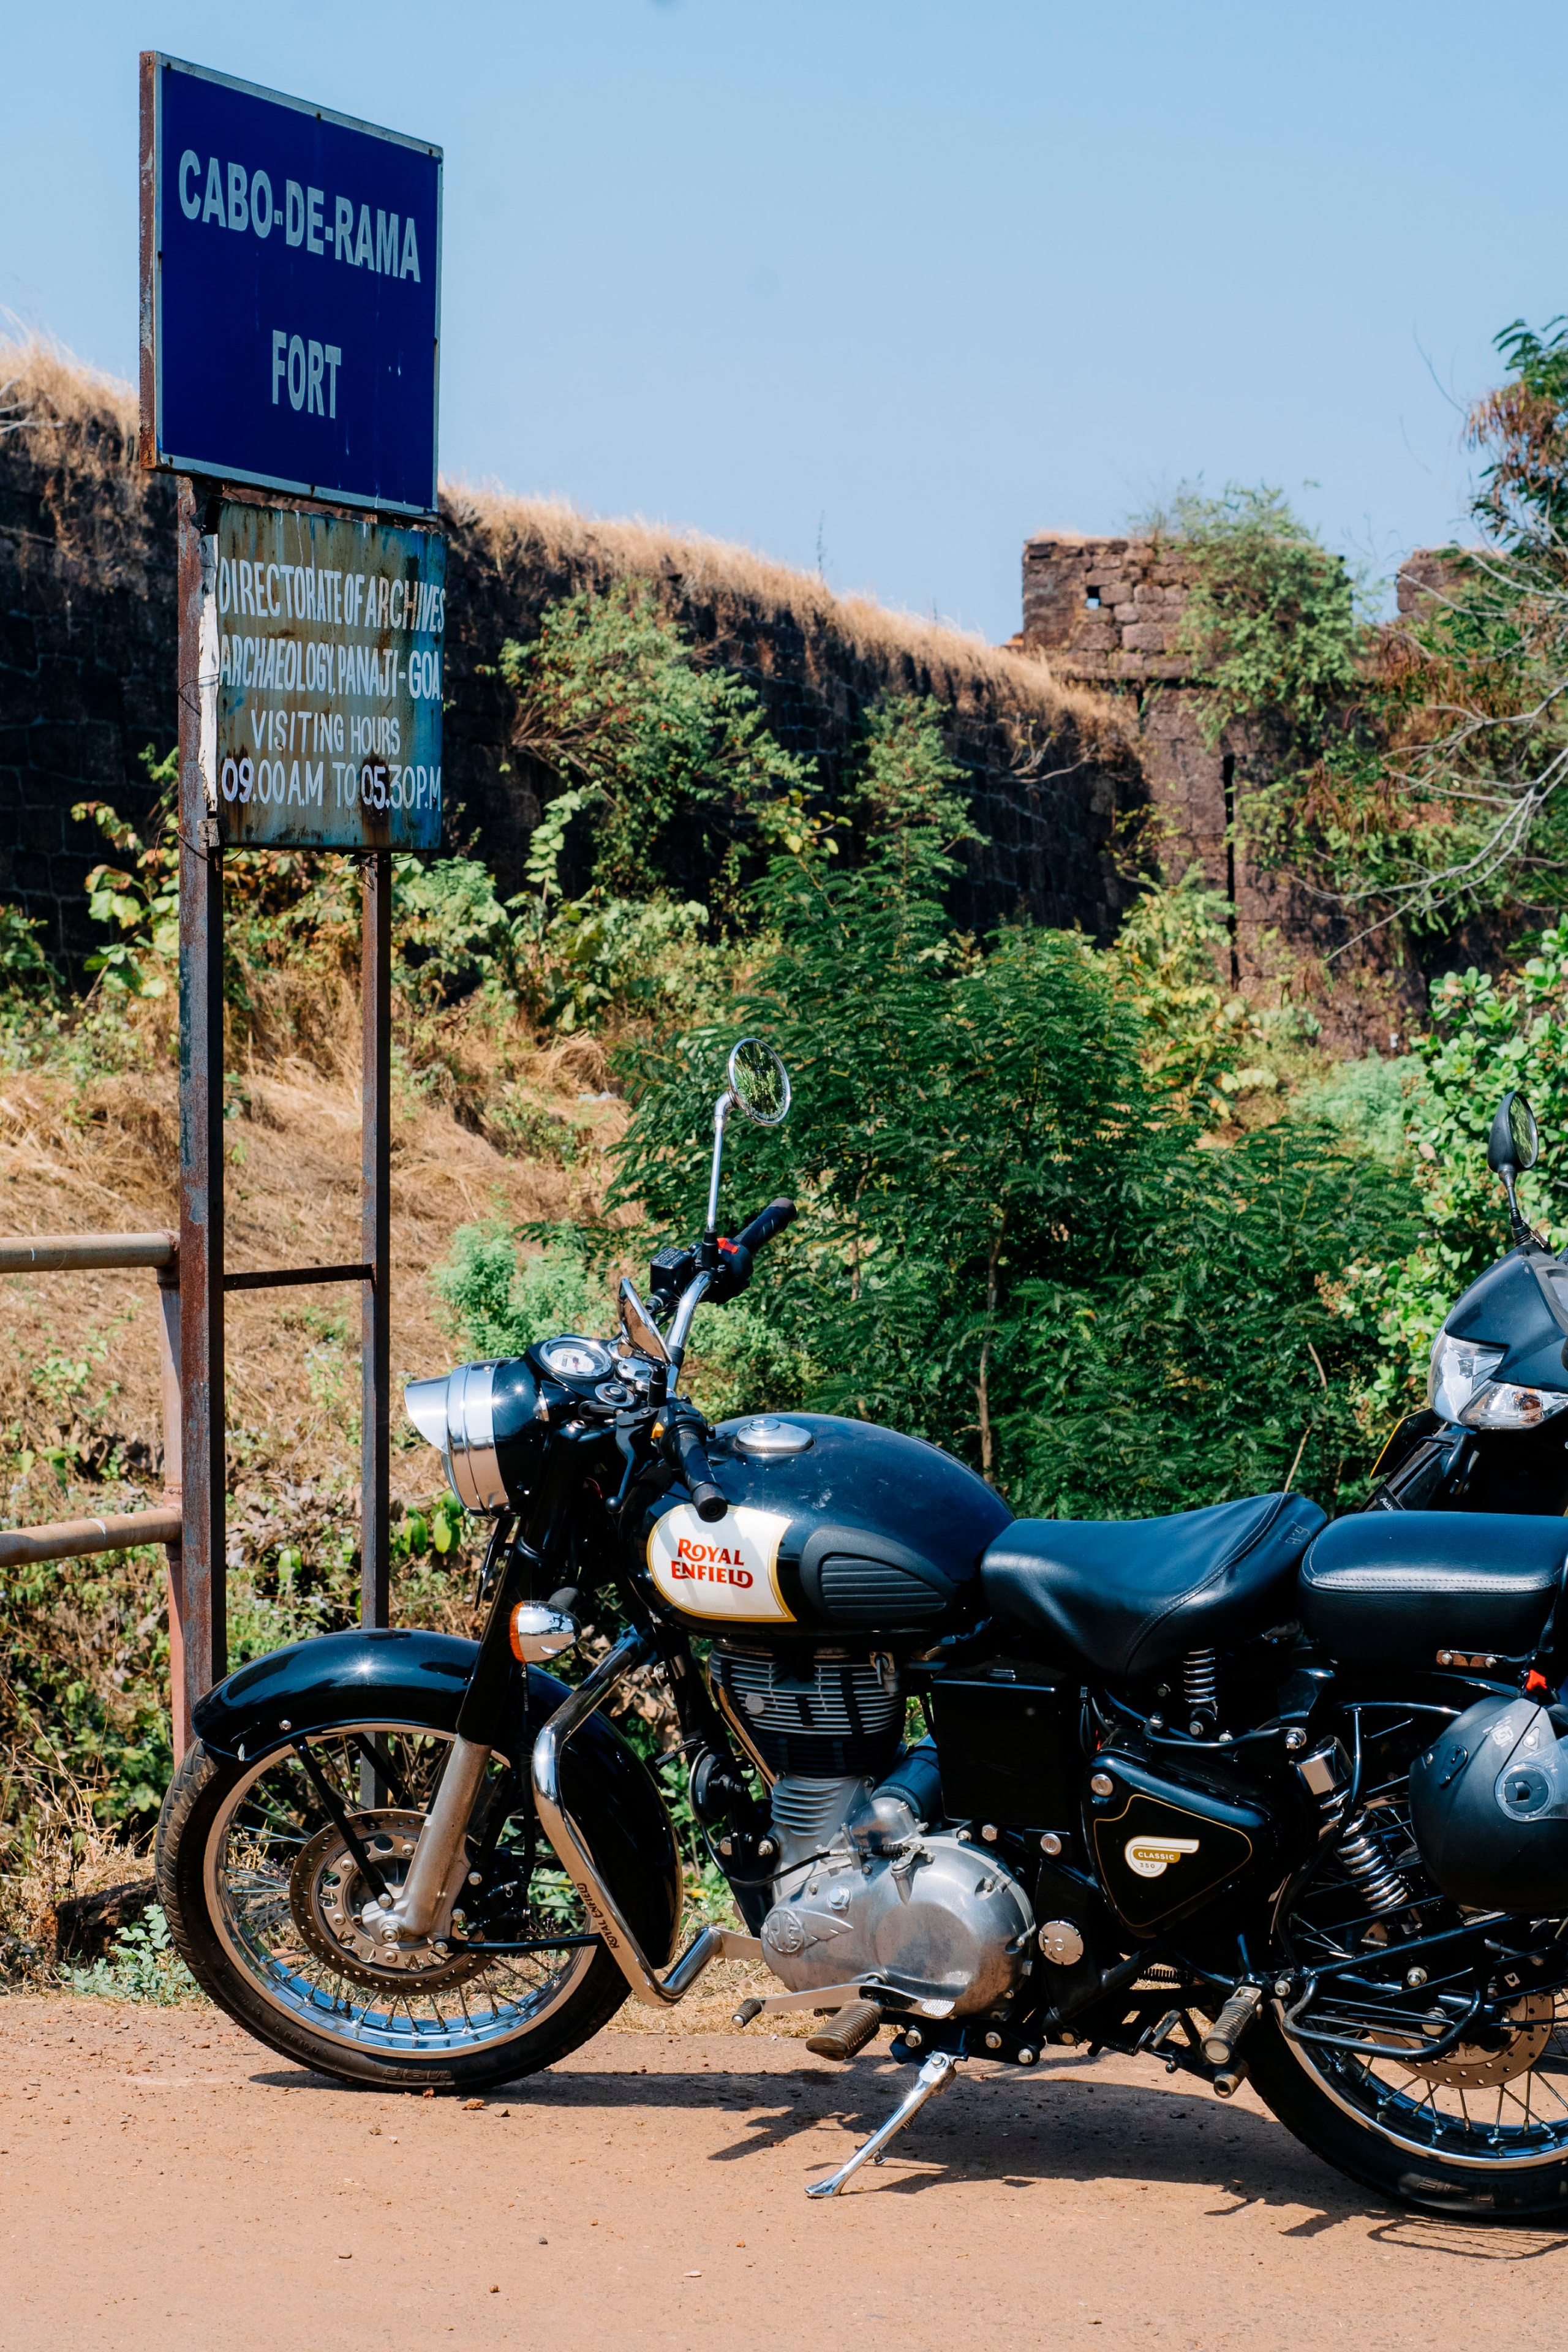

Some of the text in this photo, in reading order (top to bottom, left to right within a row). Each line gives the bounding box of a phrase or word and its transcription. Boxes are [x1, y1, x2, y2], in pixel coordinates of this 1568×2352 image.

[179, 149, 421, 283] CABO-DE-RAMA
[272, 330, 341, 419] FORT
[219, 556, 446, 633] DIRECTORATE OF ARCHIVES
[219, 634, 337, 696] ARCHAEOLOGY,
[251, 709, 400, 756] VISITING HOURS
[332, 761, 357, 807] TO
[671, 1560, 753, 1589] ENFIELD
[677, 1538, 745, 1566] ROYAL
[1137, 1851, 1174, 1860] CLASSIC
[576, 1883, 620, 1949] ROYAL ENFIELD
